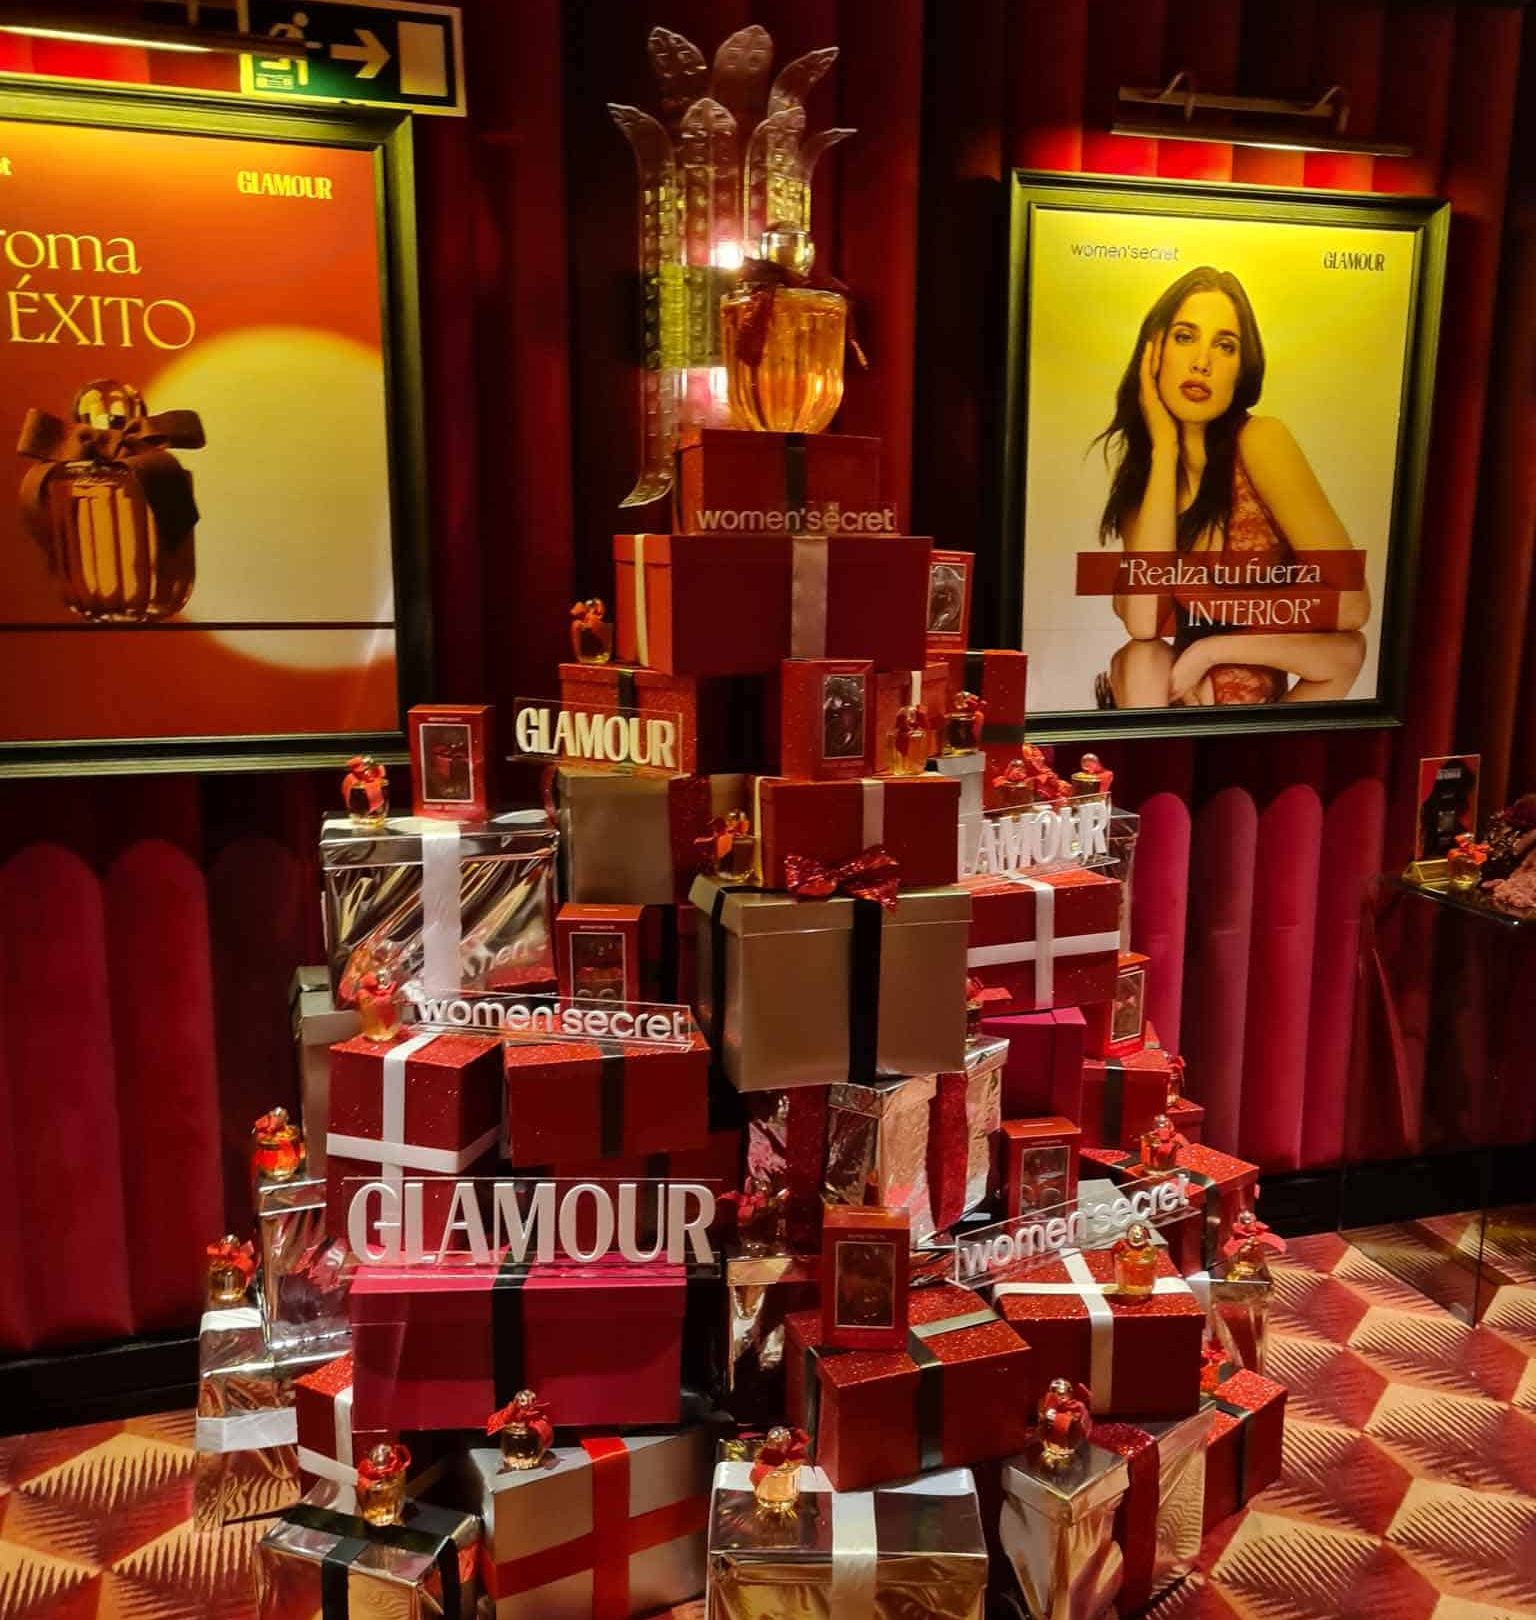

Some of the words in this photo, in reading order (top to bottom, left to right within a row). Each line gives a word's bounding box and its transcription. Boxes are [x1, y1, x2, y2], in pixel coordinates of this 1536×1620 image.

[237, 170, 333, 200] GLAMOUR
[1070, 242, 1179, 262] women'secret
[1323, 250, 1385, 272] GLAMOUR
[8, 273, 196, 350] ÉXITO
[696, 507, 896, 532] women'secret
[1214, 563, 1241, 585] tu
[1245, 557, 1321, 584] fuerza
[515, 707, 676, 768] GLAMOUR
[416, 998, 686, 1042] women'secret
[347, 1182, 717, 1265] GLAMOUR
[960, 1173, 1191, 1277] women'secret
